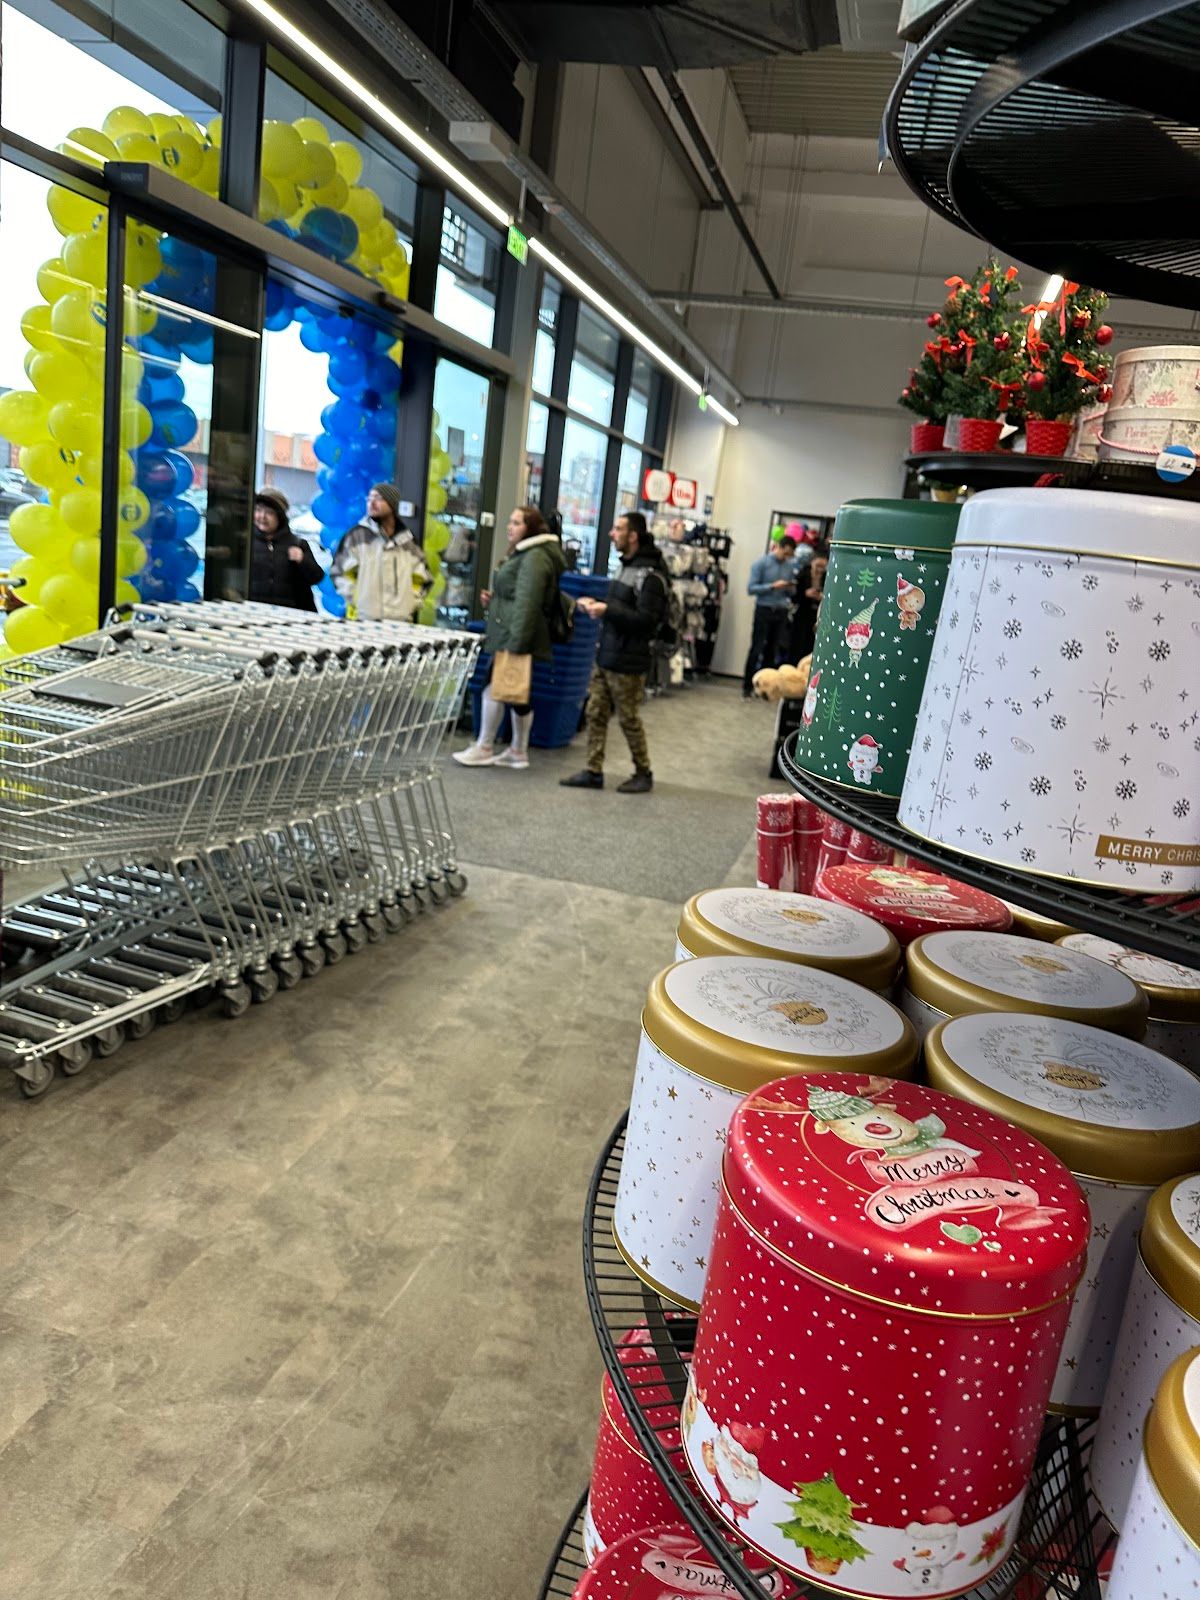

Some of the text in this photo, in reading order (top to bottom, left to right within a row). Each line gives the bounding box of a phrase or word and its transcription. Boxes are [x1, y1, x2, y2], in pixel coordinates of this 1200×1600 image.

[1108, 842, 1162, 860] MERRY
[877, 1153, 966, 1182] Merry
[875, 1186, 997, 1224] Christmas
